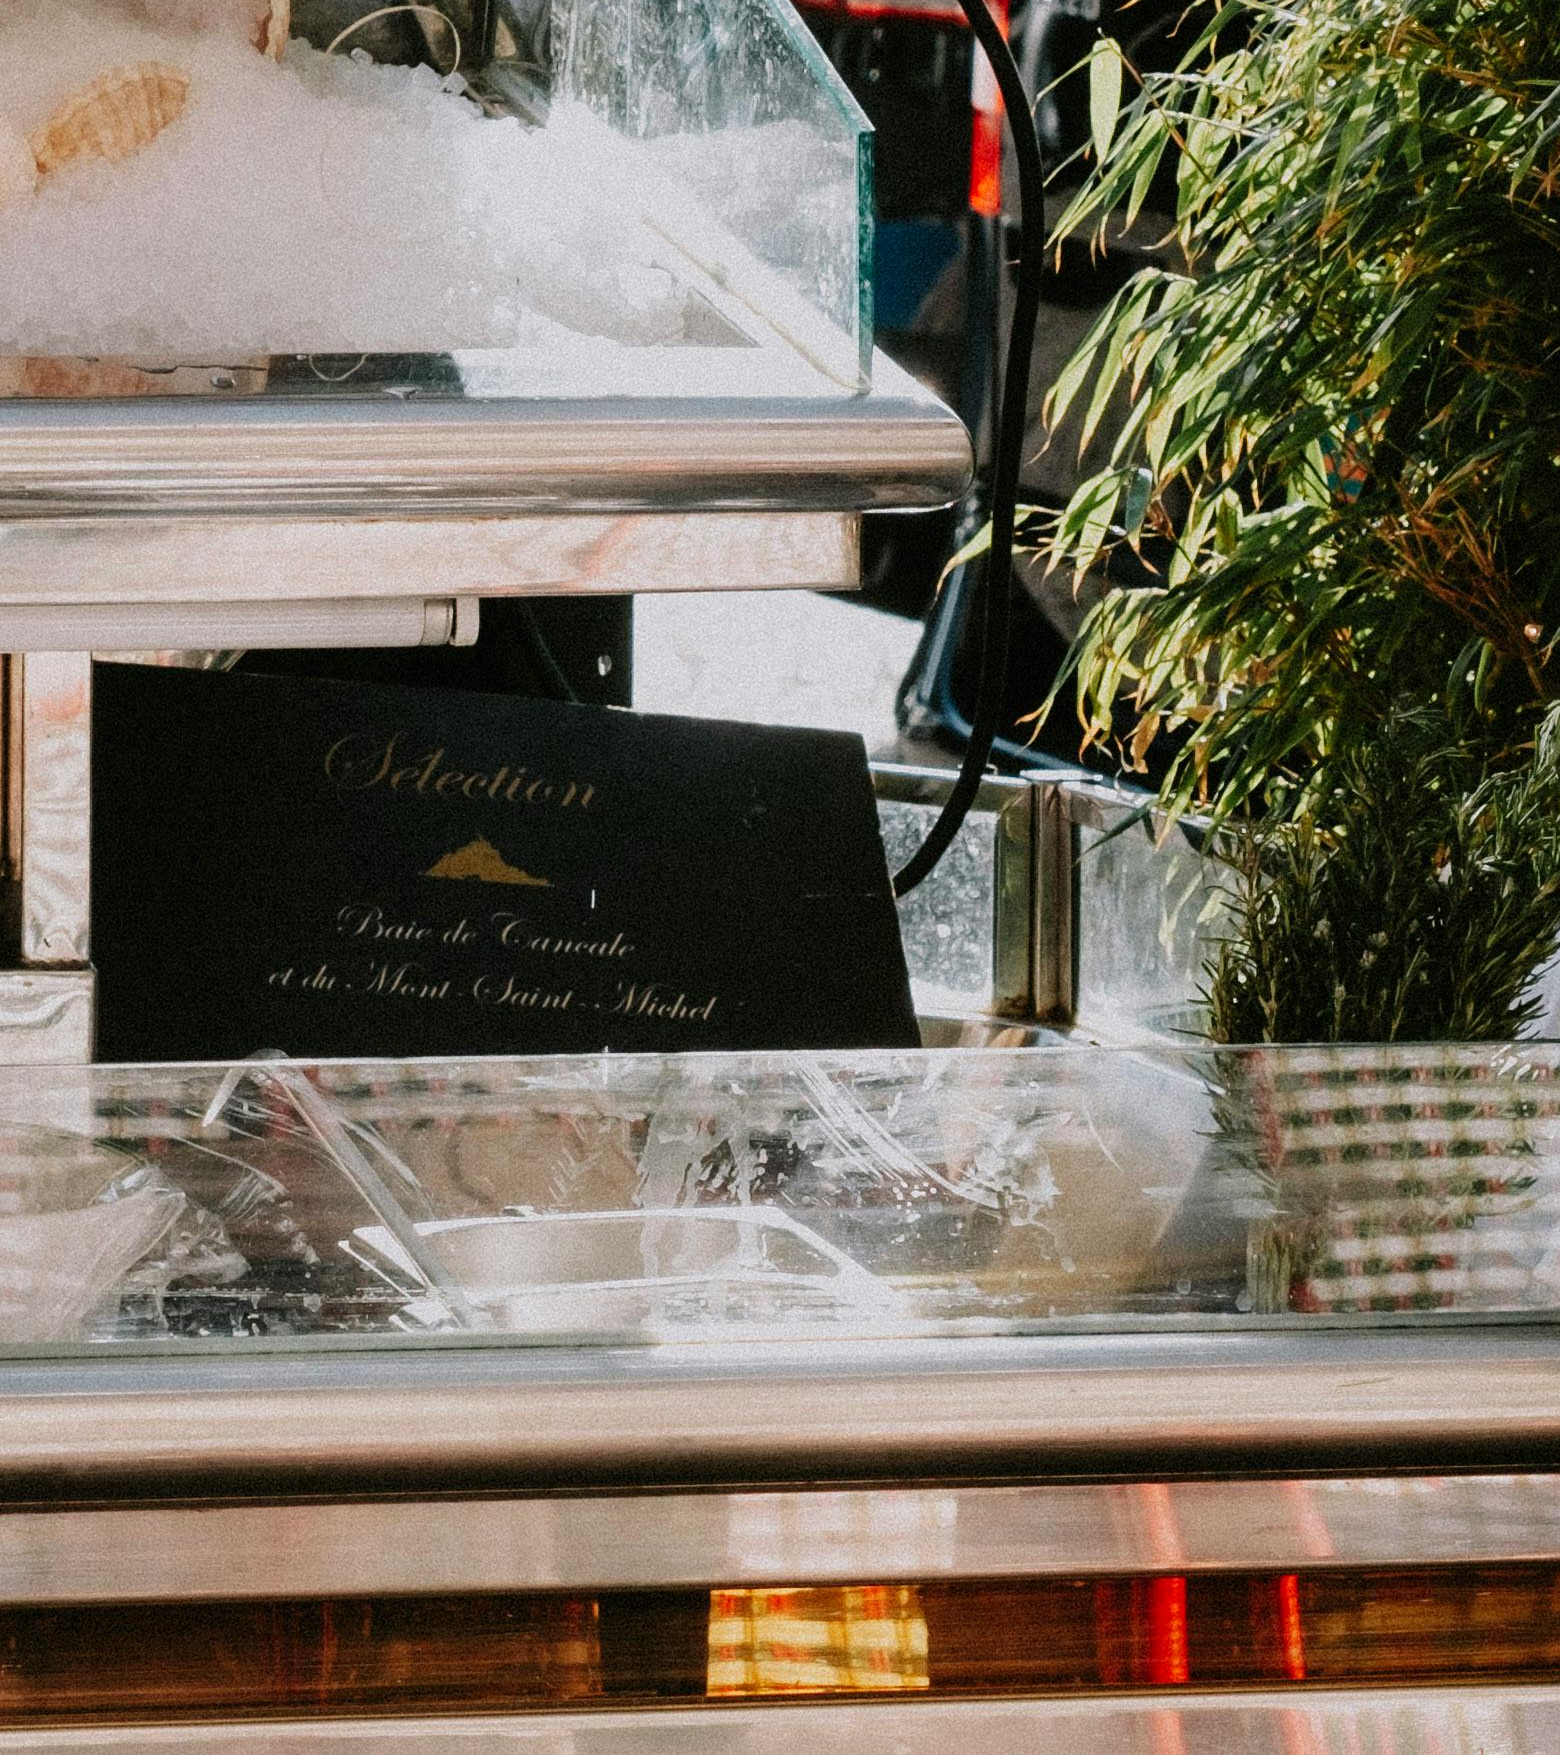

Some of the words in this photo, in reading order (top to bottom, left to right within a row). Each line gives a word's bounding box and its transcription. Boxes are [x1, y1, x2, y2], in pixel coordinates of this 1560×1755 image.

[337, 903, 433, 940] Baie
[442, 918, 478, 944] de
[490, 911, 636, 957] Cancale
[267, 967, 295, 987] et
[301, 963, 337, 991] du
